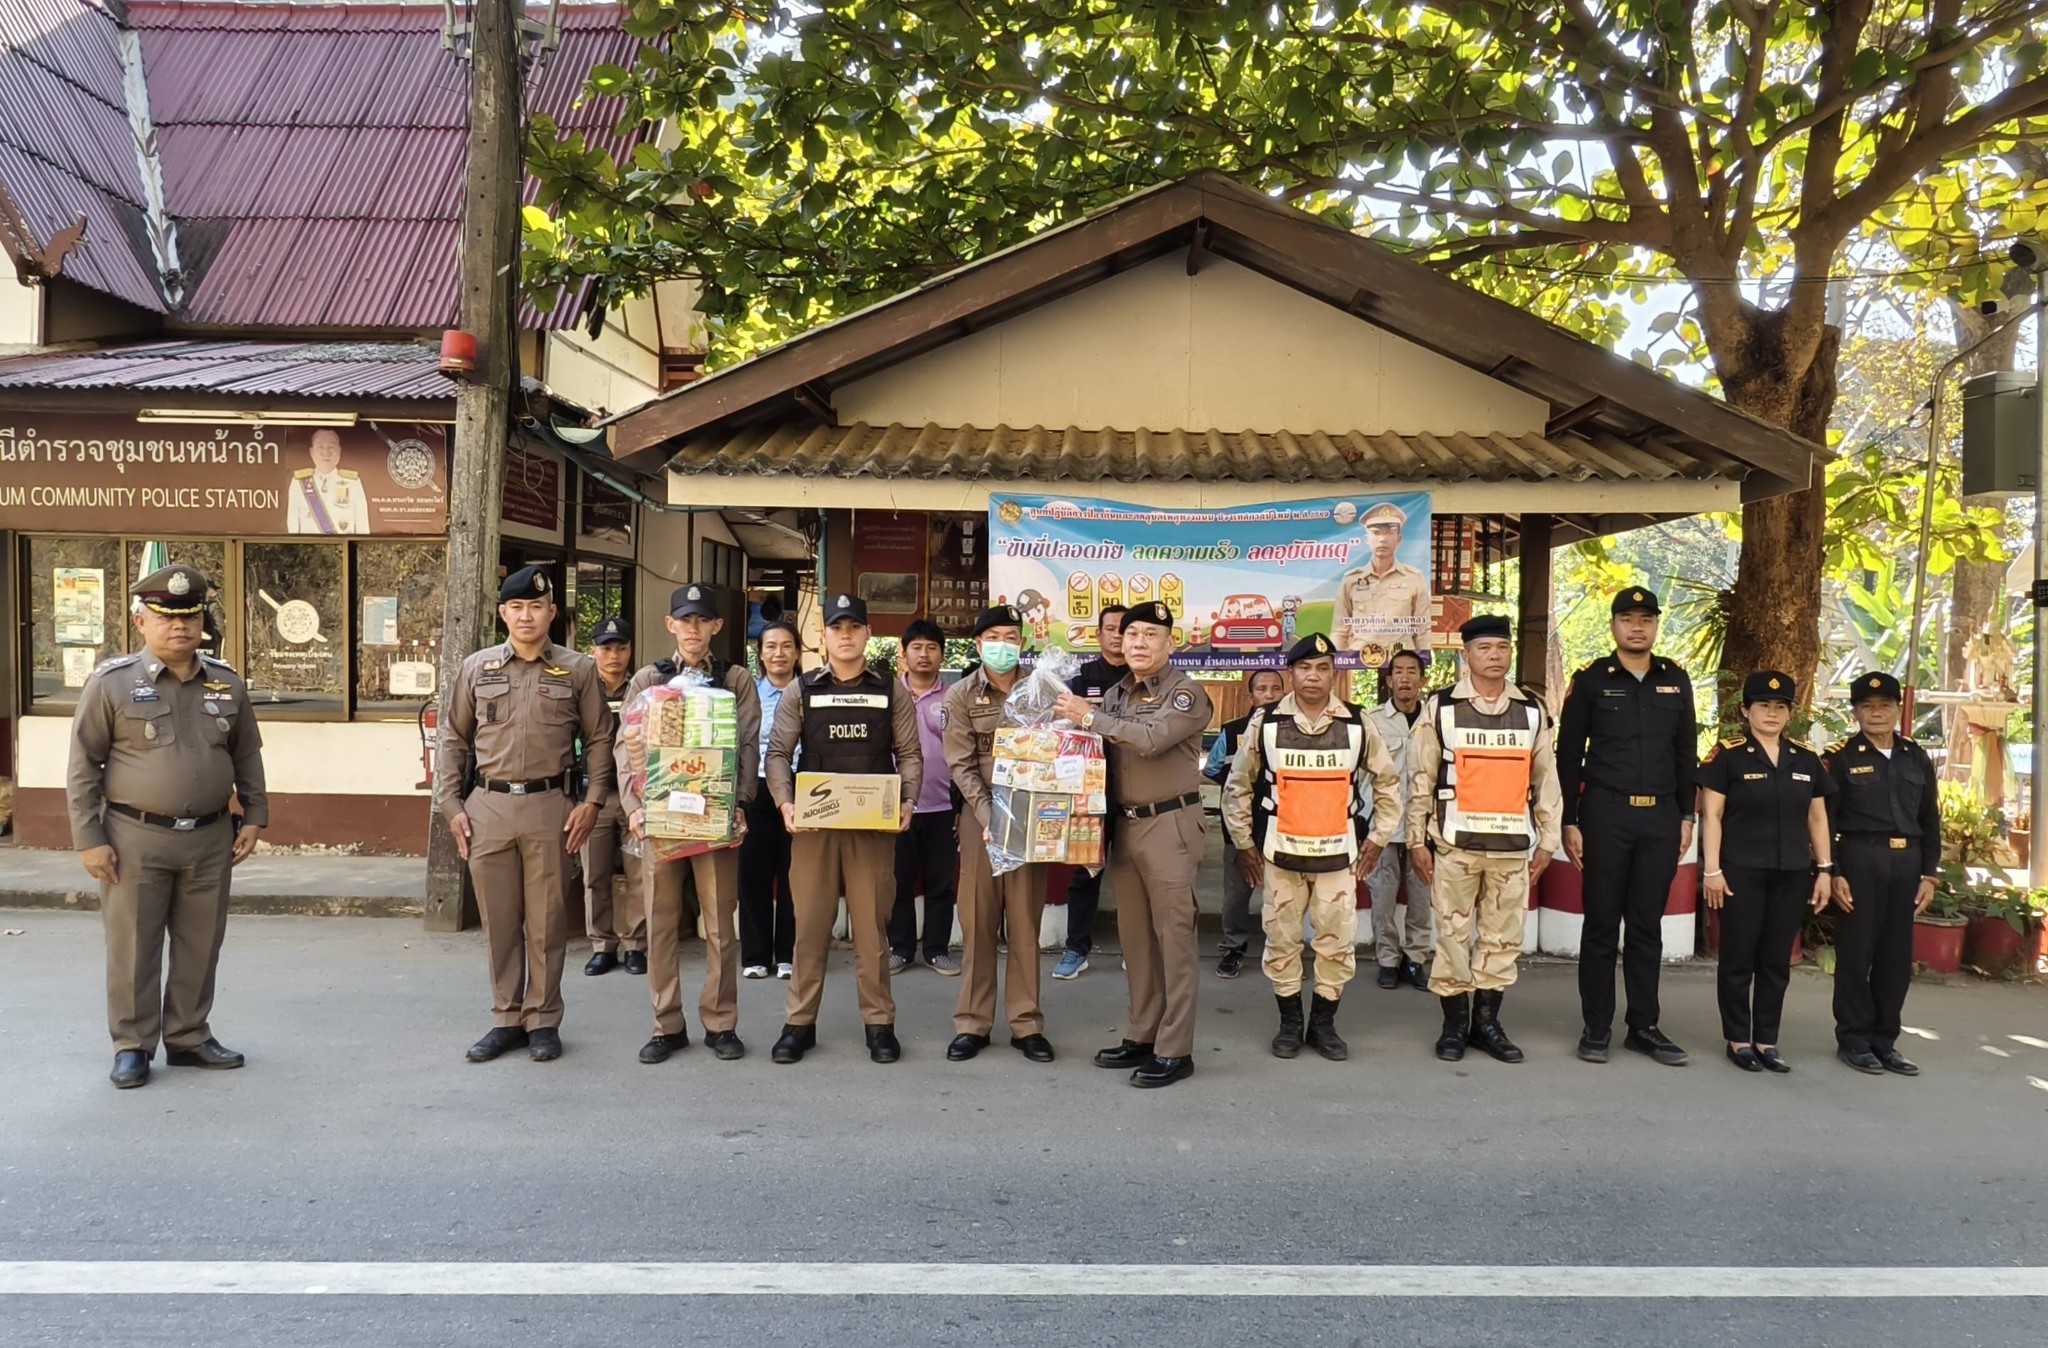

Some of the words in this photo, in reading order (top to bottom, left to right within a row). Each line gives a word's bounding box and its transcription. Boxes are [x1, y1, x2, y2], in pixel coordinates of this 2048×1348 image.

[0, 486, 26, 507] UM
[31, 486, 136, 507] COMMUNITY
[142, 487, 200, 508] POLICE
[205, 488, 279, 509] STATION
[1132, 540, 1240, 561] ลดความเร็ว
[828, 723, 868, 739] POLICE
[1466, 732, 1523, 747] บก.อส.
[1285, 753, 1343, 768] บก.อส.
